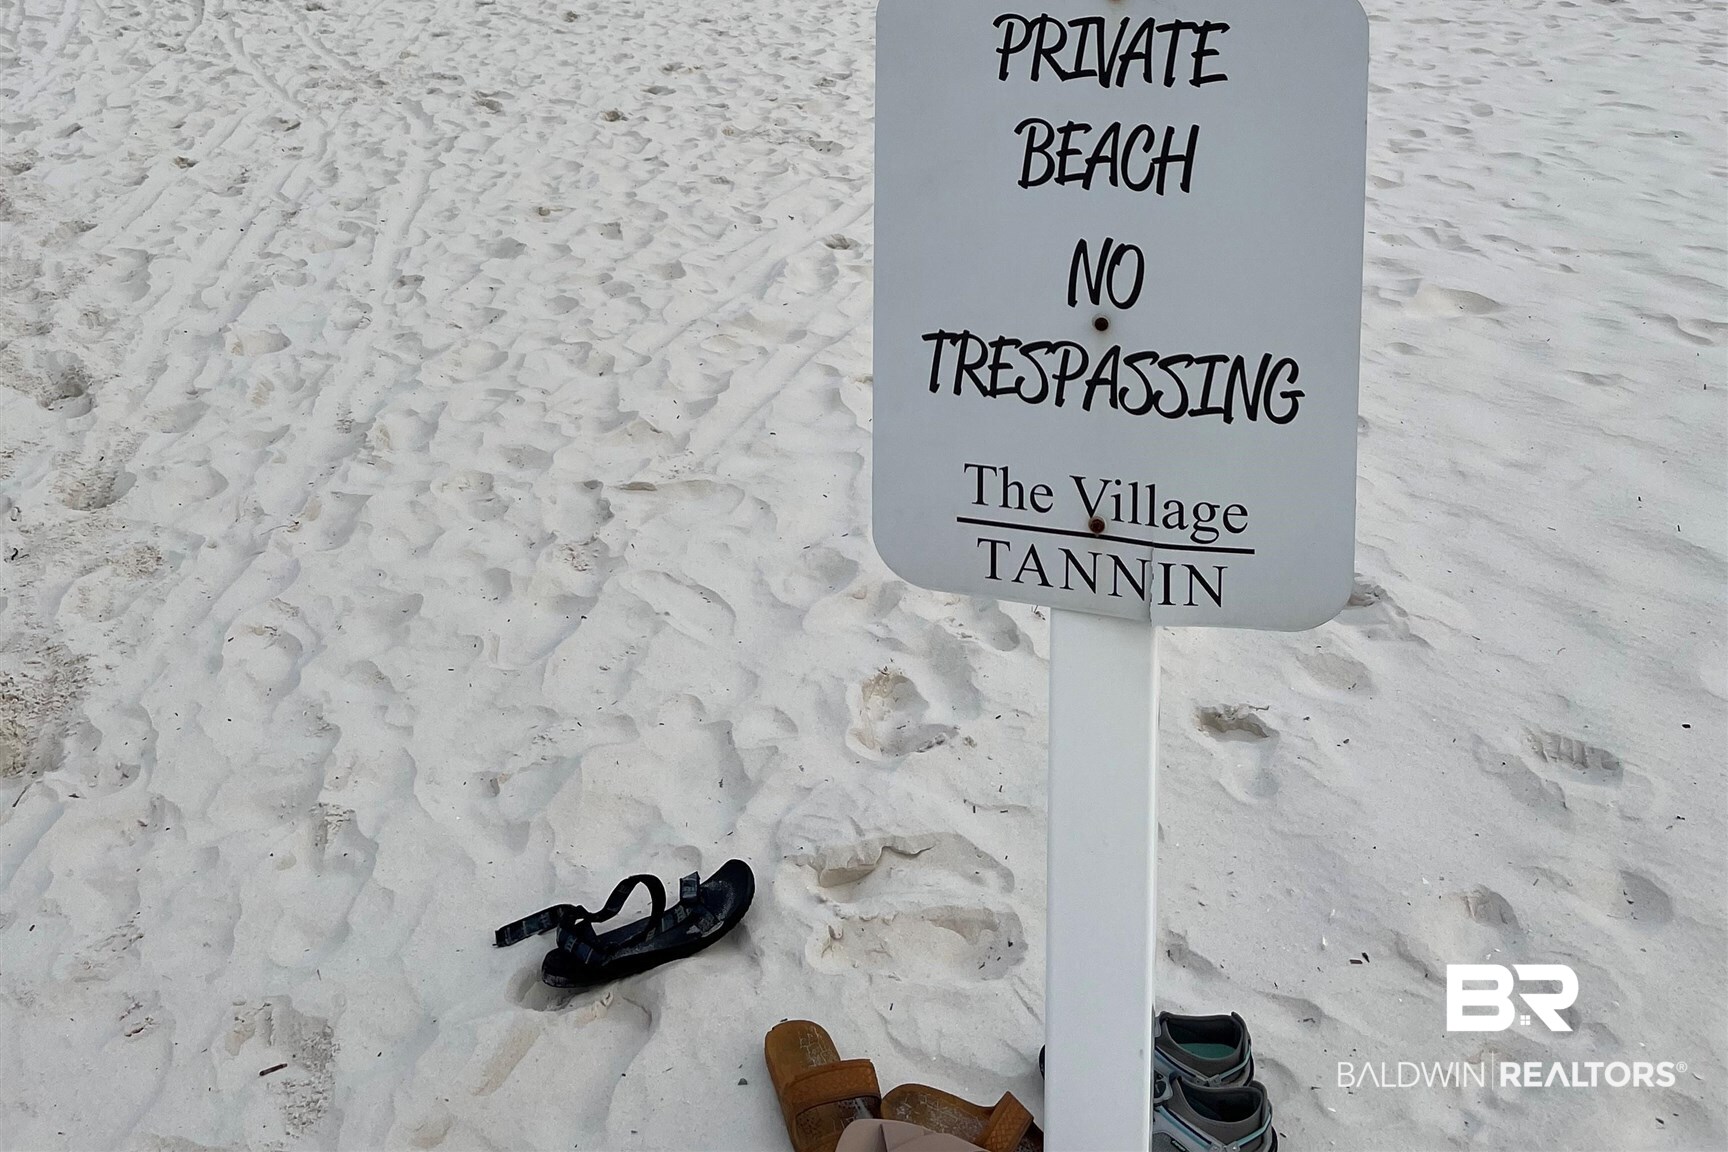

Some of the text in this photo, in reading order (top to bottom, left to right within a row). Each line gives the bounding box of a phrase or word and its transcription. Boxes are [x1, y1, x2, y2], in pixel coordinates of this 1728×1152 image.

[993, 13, 1230, 88] PRIVATE
[1014, 118, 1199, 196] BEACH
[1067, 237, 1145, 310] NO
[921, 329, 1306, 424] TRESPASSING
[963, 463, 1249, 543] The Village
[977, 537, 1226, 609] TANNIN
